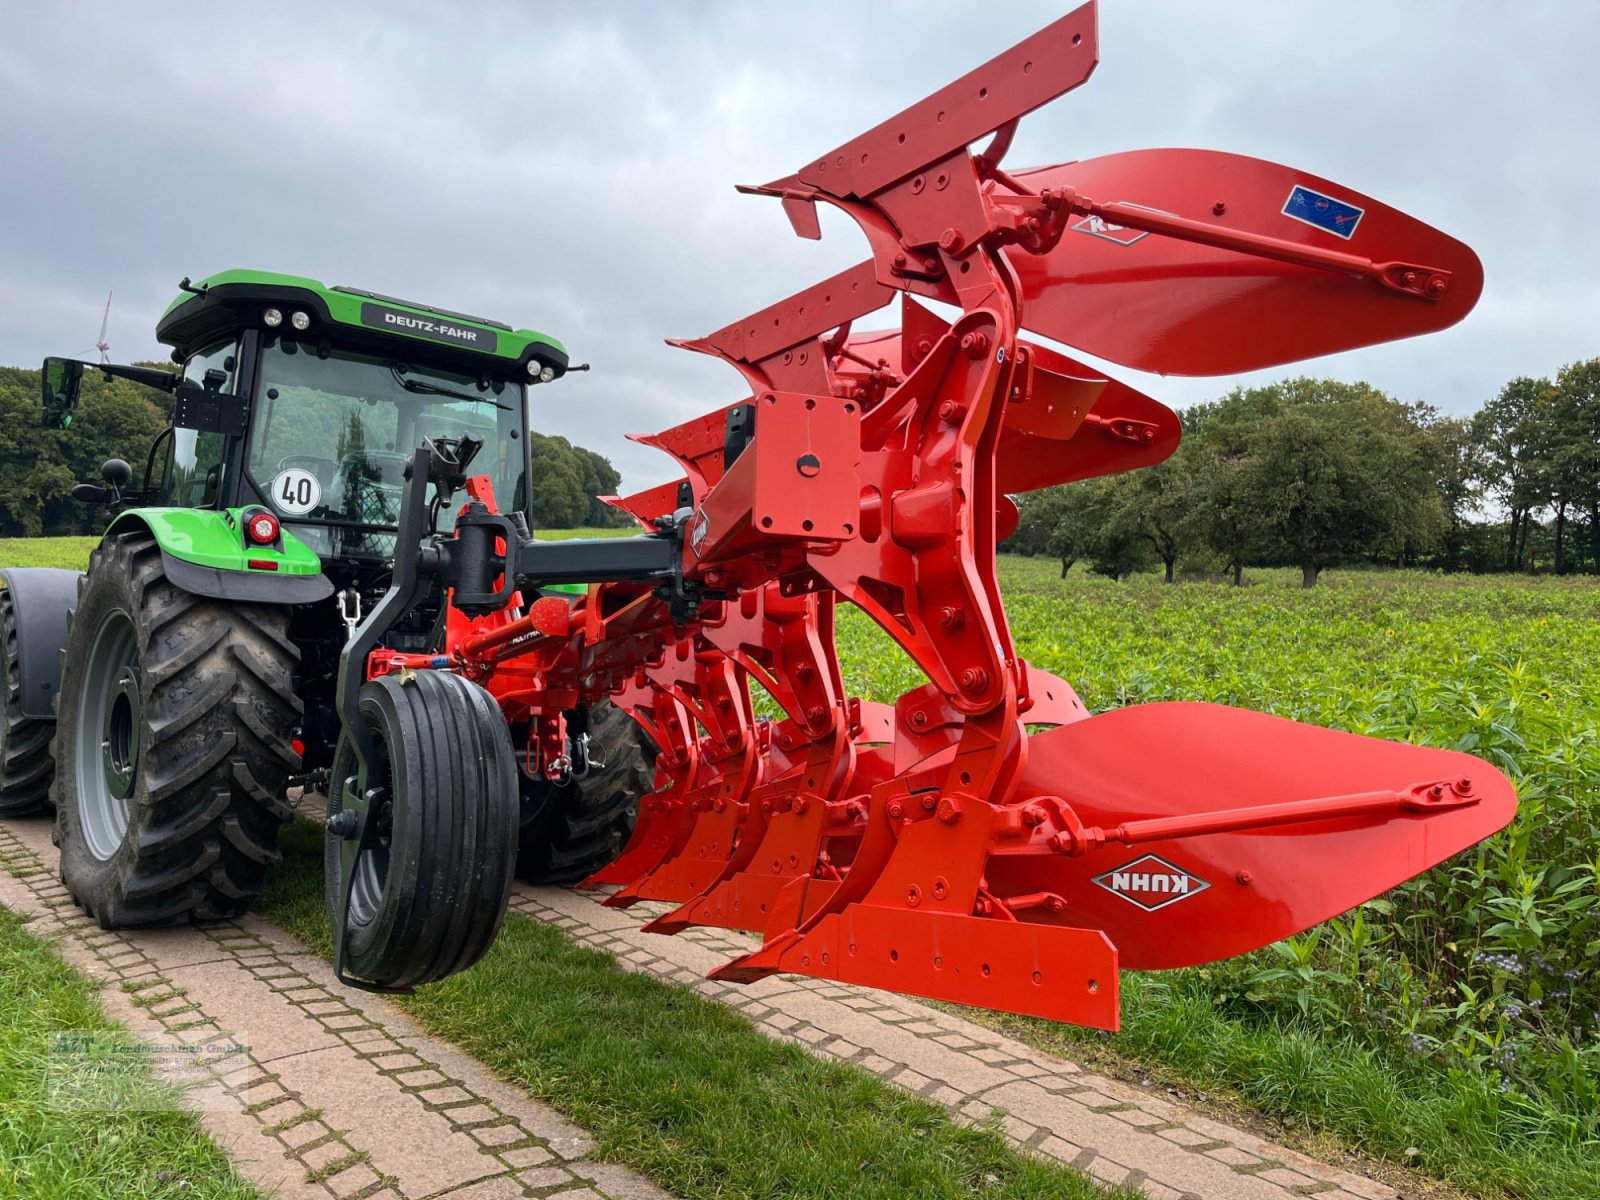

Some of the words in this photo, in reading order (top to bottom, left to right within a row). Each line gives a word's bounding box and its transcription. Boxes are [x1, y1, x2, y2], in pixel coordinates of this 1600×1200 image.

[384, 313, 477, 341] DEUTZ-FAHR
[282, 476, 311, 506] 40
[1112, 872, 1188, 893] KUHN
